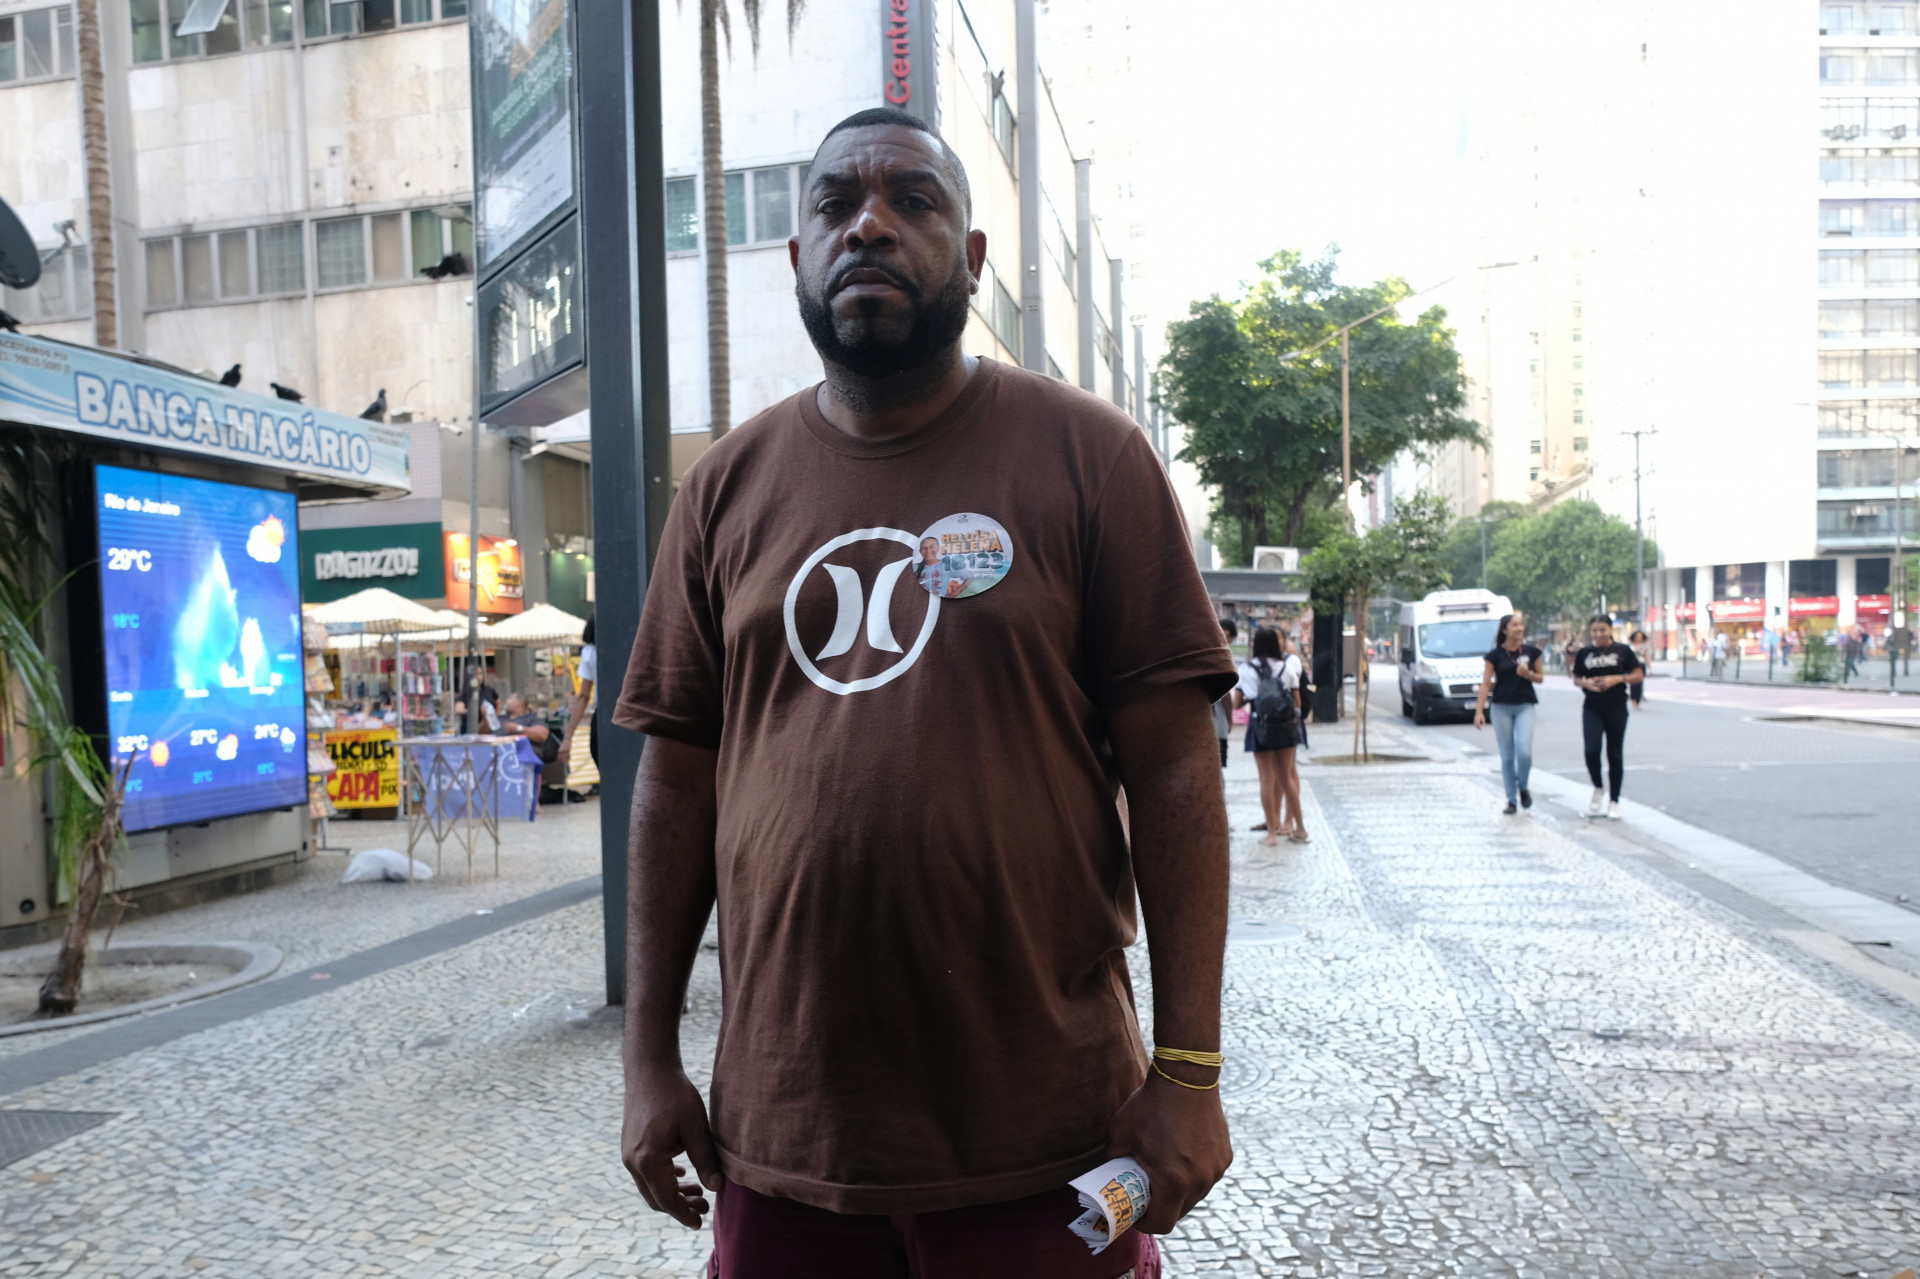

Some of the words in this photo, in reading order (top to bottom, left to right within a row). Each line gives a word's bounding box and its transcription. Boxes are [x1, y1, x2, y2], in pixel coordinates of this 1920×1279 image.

[75, 371, 221, 446] BANCA
[224, 405, 371, 475] MACÁRIO
[315, 547, 419, 580] RAGAZZO!
[942, 539, 1003, 555] HELENA
[942, 552, 1004, 571] 18123
[1106, 1178, 1133, 1230] ELENA
